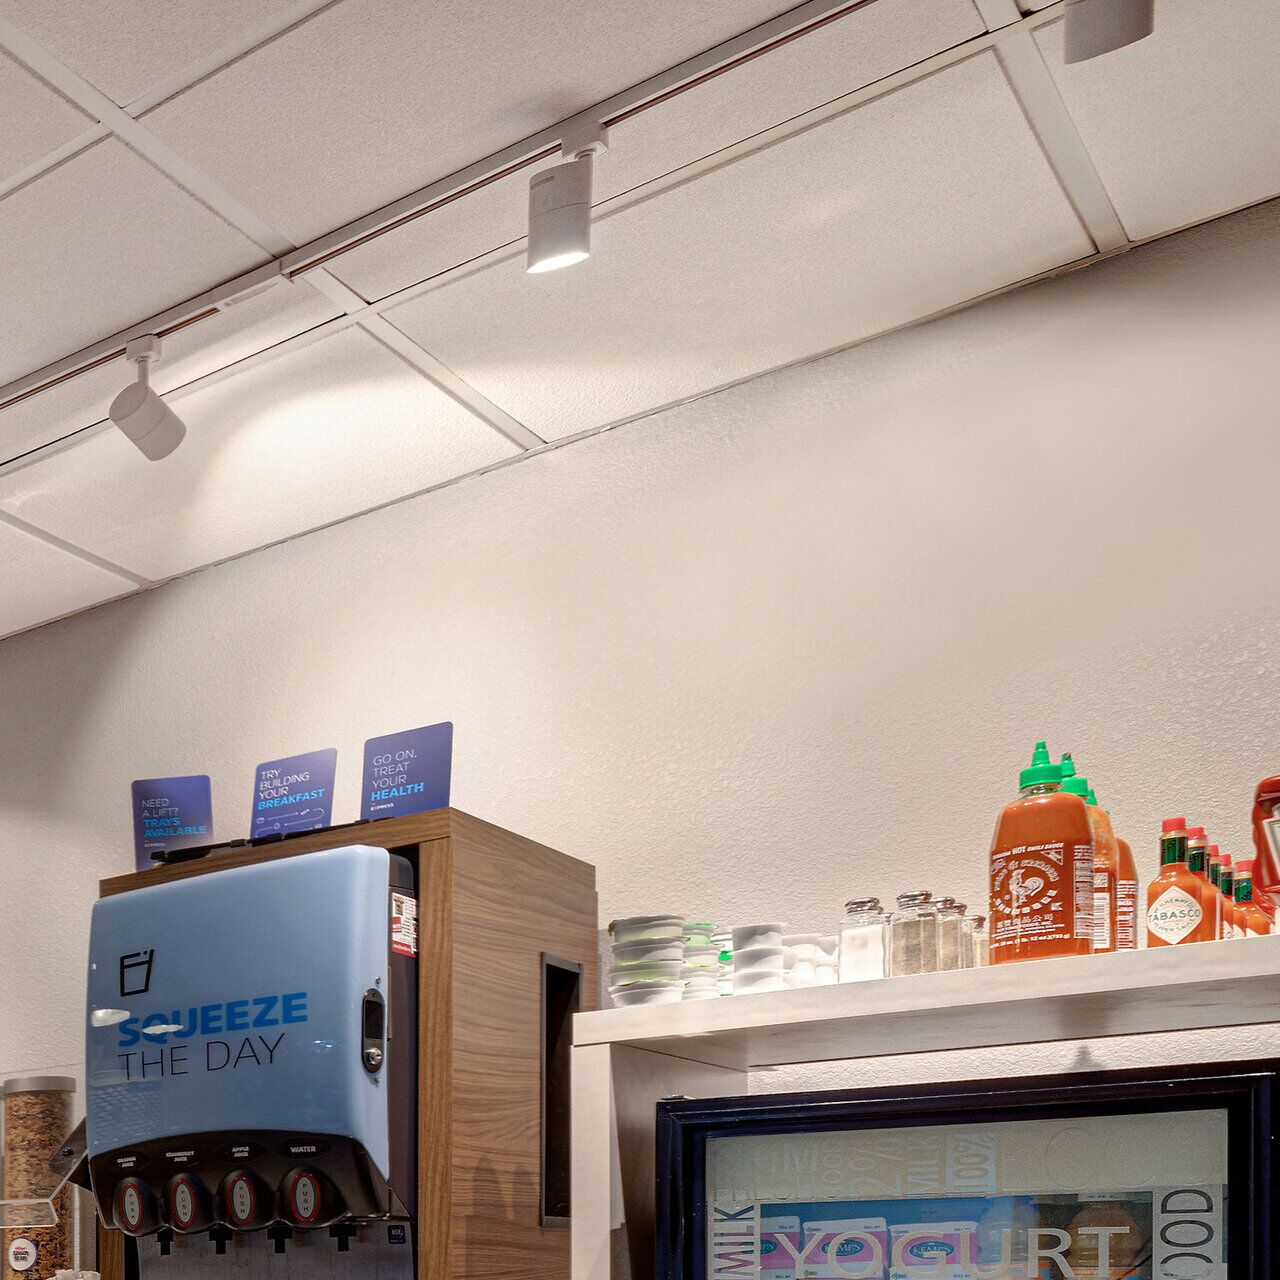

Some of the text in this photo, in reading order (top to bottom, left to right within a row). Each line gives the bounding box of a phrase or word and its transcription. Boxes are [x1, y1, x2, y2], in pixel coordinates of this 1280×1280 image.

[373, 749, 417, 766] GO ON.
[261, 769, 282, 780] TRY
[373, 761, 410, 778] TREAT
[259, 772, 310, 790] BUILDING
[372, 775, 407, 789] YOUR
[257, 788, 326, 810] BREAKFAST
[259, 786, 289, 800] YOUR
[371, 782, 424, 801] HEALTH
[141, 798, 169, 808] NEED
[142, 807, 179, 818] A LIFT?
[143, 816, 181, 828] TRAYS
[143, 825, 208, 838] AVAILABLE
[1147, 908, 1201, 923] TABASCO
[118, 991, 309, 1047] SQUEEZE
[117, 1032, 286, 1081] THE DAY
[290, 1145, 317, 1154] WATER
[952, 1132, 994, 1190] 100%
[180, 1189, 188, 1217] PUSH
[713, 1204, 755, 1278] MILK
[773, 1225, 1131, 1280] YOGURT
